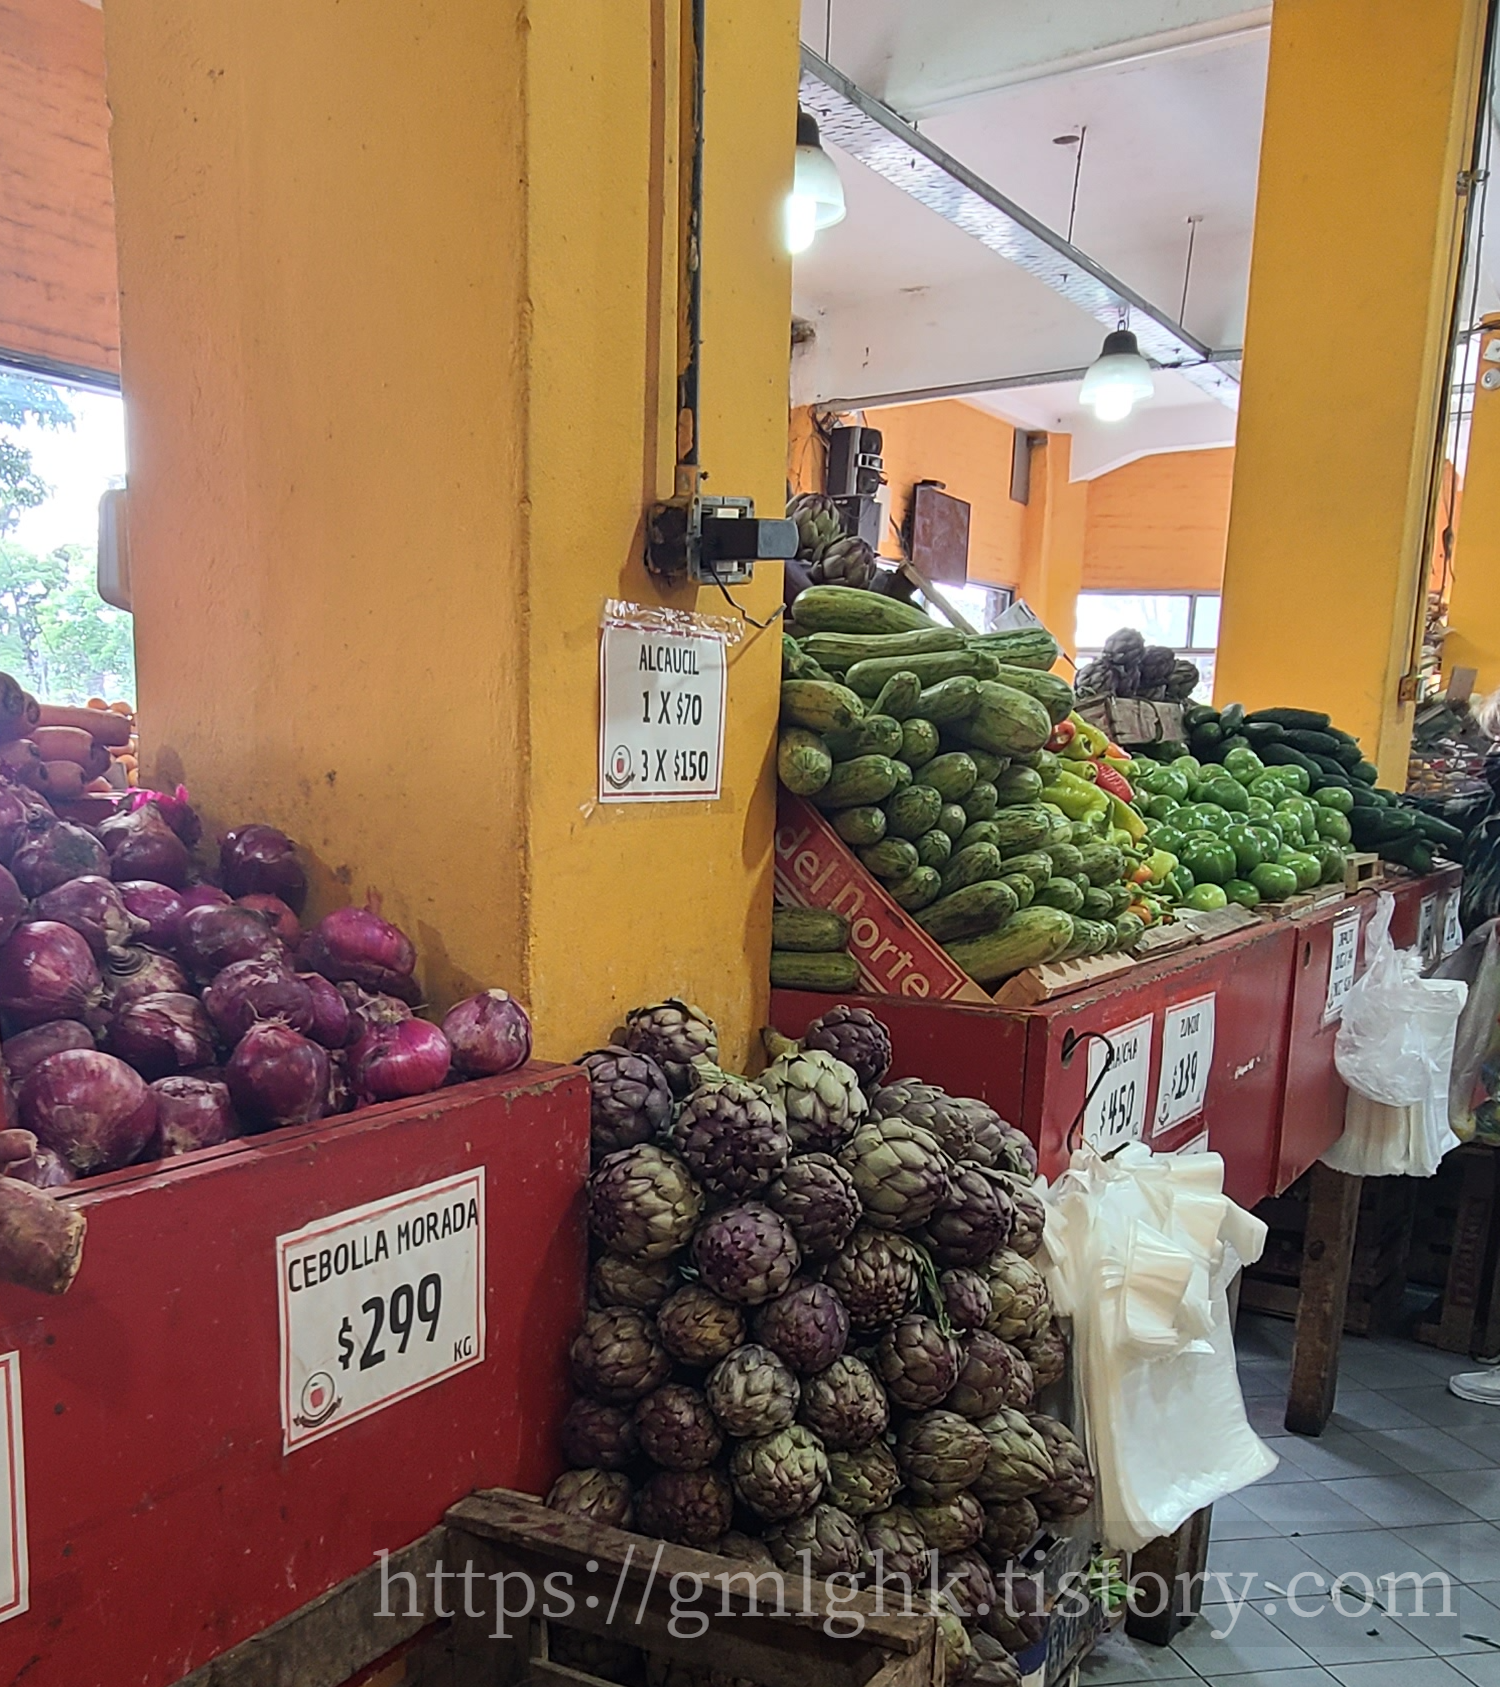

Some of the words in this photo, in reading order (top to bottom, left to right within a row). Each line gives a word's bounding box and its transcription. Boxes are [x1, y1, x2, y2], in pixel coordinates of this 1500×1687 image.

[638, 643, 700, 676] ALCAUCIL
[642, 690, 650, 723] 1
[658, 690, 671, 725] X
[676, 692, 702, 726] $70
[641, 750, 649, 782] 3
[655, 749, 668, 782] X
[674, 749, 708, 782] $150
[775, 825, 839, 895] del
[827, 881, 930, 998] norte
[1100, 1080, 1135, 1136] $450
[288, 1229, 389, 1293] CEBOLLA
[397, 1197, 479, 1255] MORADA
[338, 1272, 442, 1372] $299
[453, 1335, 472, 1362] KG
